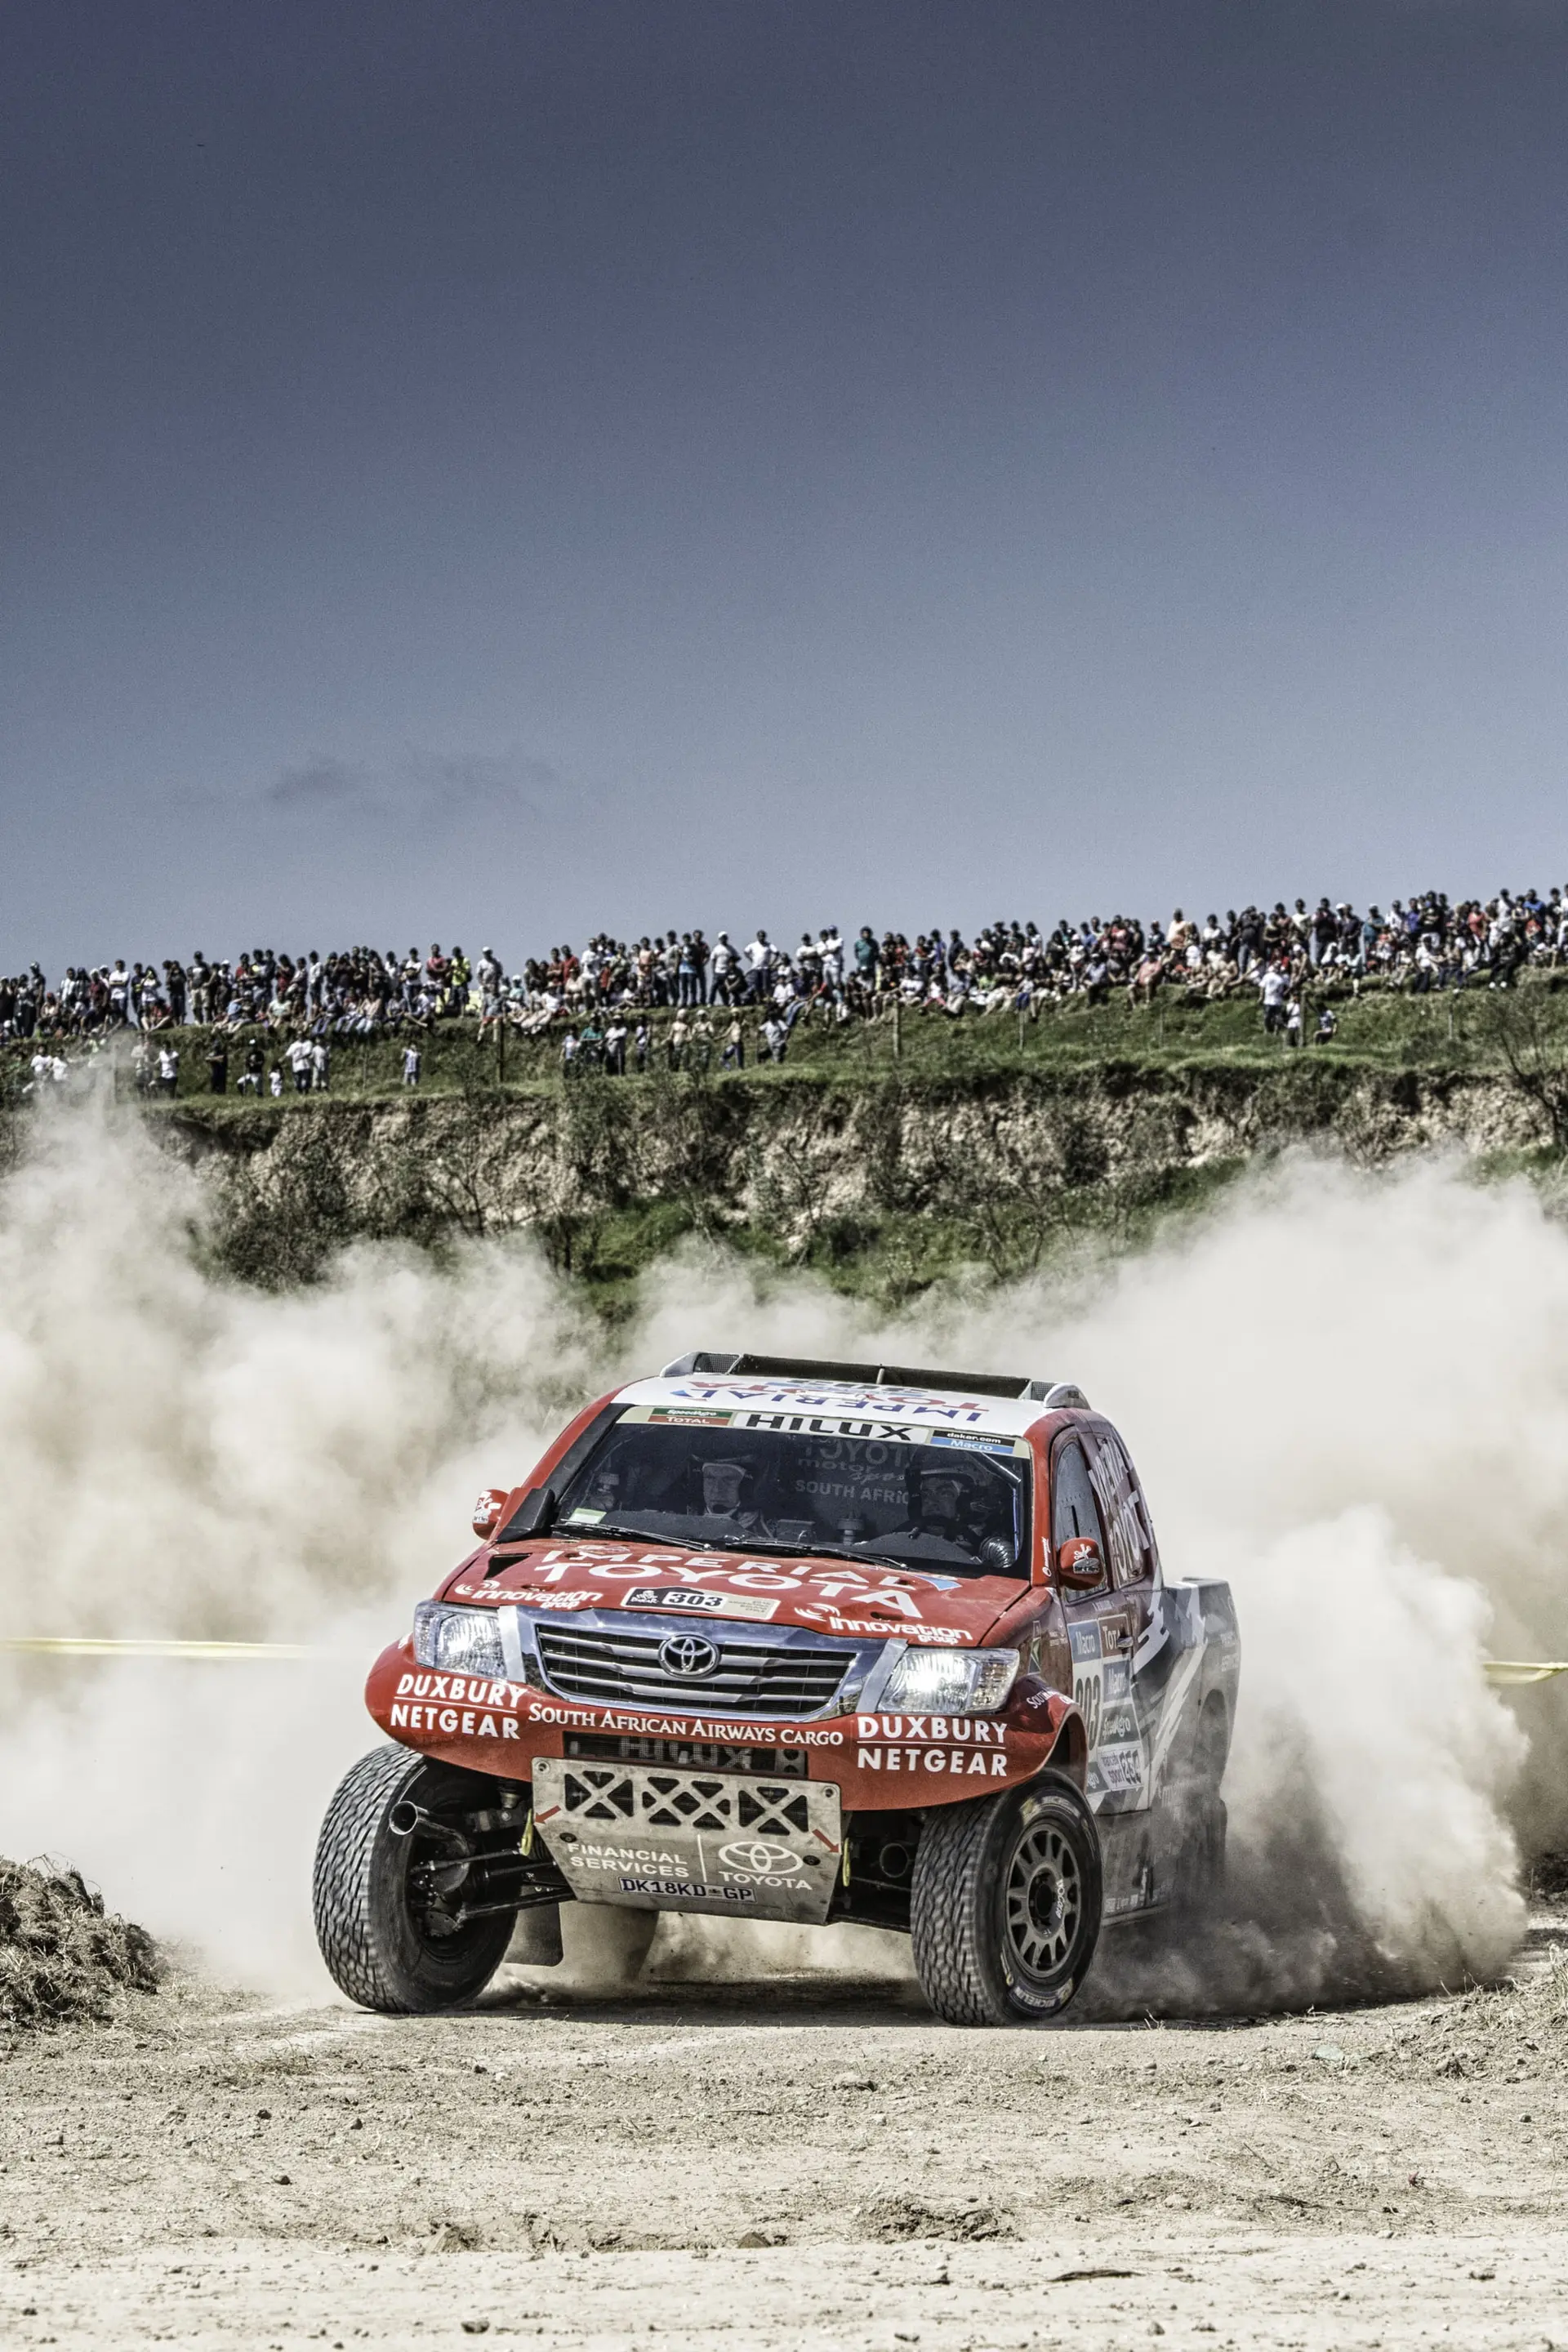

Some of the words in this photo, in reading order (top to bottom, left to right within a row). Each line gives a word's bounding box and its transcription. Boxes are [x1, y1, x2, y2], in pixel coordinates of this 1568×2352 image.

[690, 1389, 982, 1422] IMPERIAL
[666, 1416, 710, 1424] TOTAL
[746, 1414, 912, 1441] HILUX
[947, 1432, 1001, 1445] dakar.com
[950, 1439, 993, 1452] Macro
[798, 1459, 876, 1472] motor
[795, 1479, 855, 1499] SOUTH
[541, 1550, 916, 1591] IMPERIAL
[471, 1590, 603, 1602] innovation
[534, 1562, 923, 1619] TOYOTA
[668, 1592, 724, 1607] 303
[539, 1601, 580, 1609] group
[829, 1616, 973, 1641] innovation
[917, 1634, 959, 1645] group
[1075, 1631, 1095, 1655] Macro
[396, 1674, 528, 1708] DUXBURY
[390, 1704, 521, 1740] NETGEAR
[528, 1703, 595, 1726] SOUTH
[600, 1710, 687, 1735] AFRICAN
[690, 1718, 776, 1743] AIRWAYS
[780, 1729, 844, 1746] CARGO
[858, 1716, 1008, 1744] DUXBURY
[858, 1748, 1008, 1777] NETGEAR
[568, 1843, 688, 1865] FINANCIAL
[569, 1856, 690, 1878] SERVICES
[621, 1878, 706, 1897] DK18KD
[723, 1887, 752, 1900] GP
[719, 1871, 813, 1891] TOYOTA
